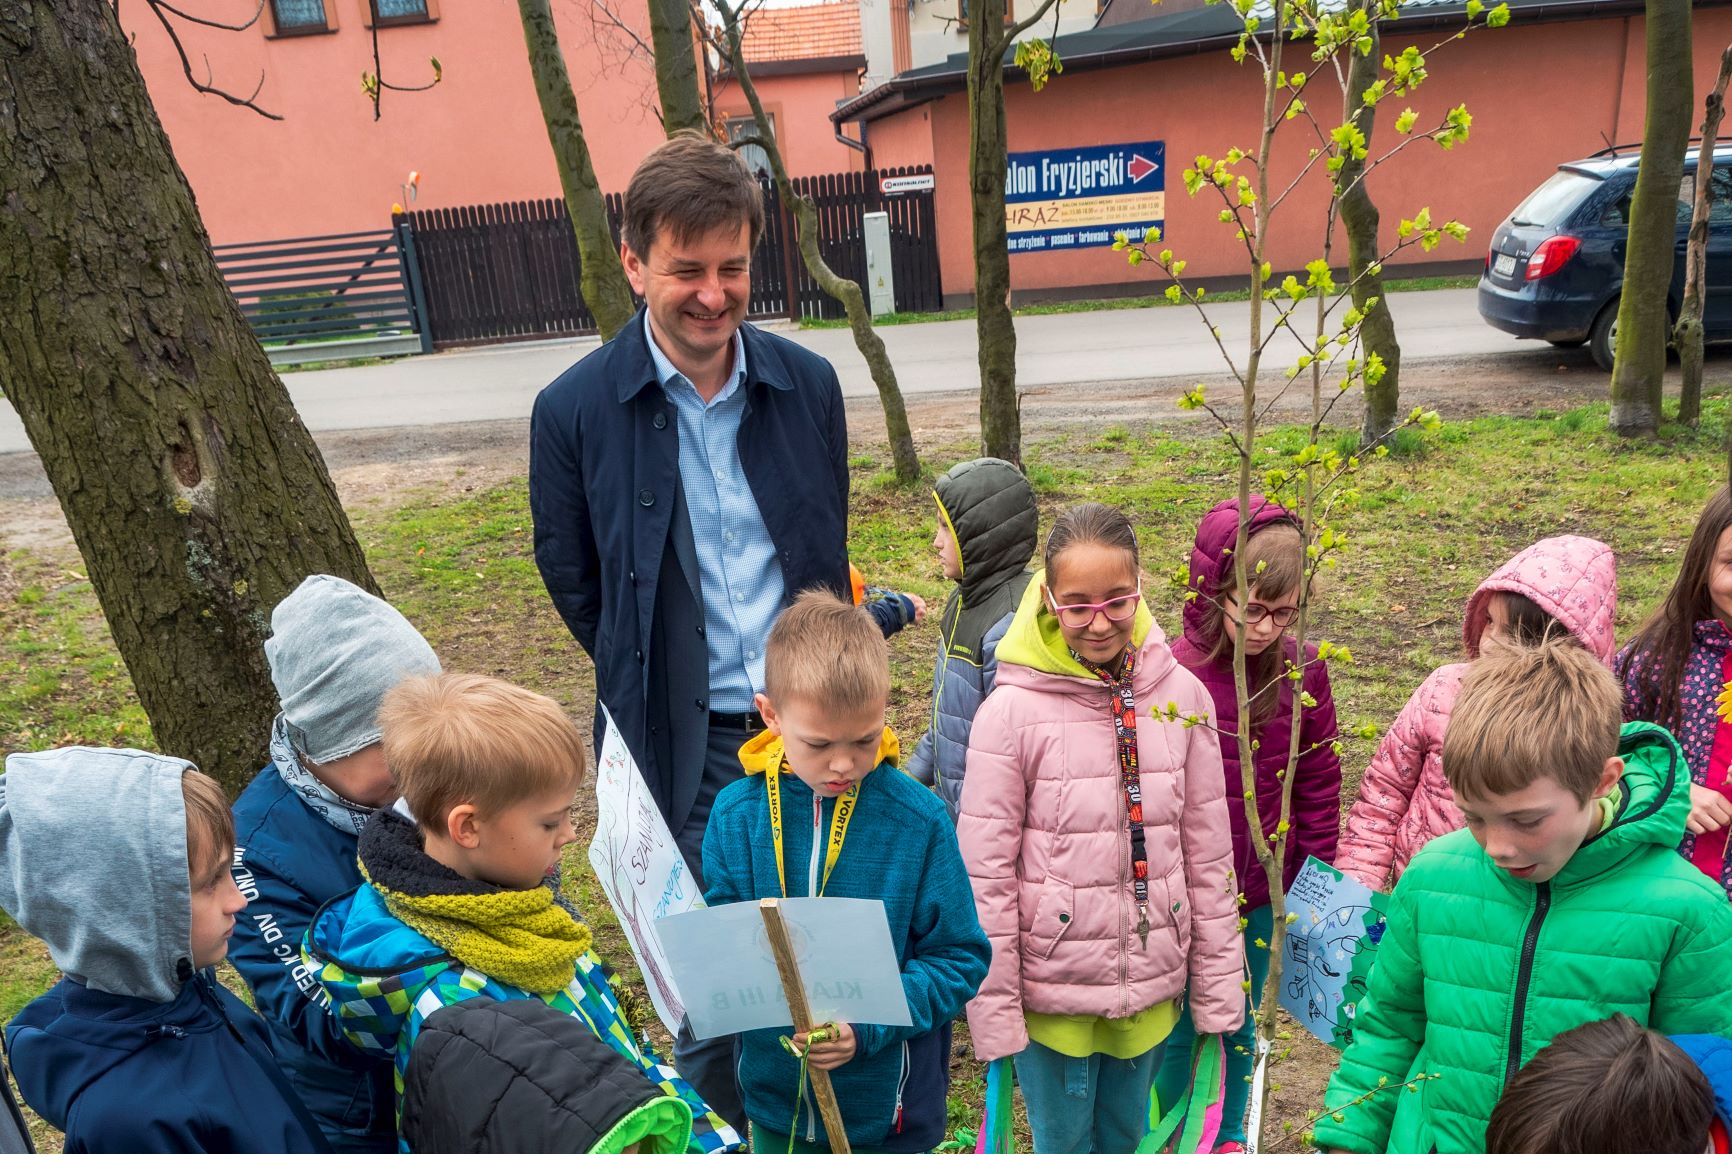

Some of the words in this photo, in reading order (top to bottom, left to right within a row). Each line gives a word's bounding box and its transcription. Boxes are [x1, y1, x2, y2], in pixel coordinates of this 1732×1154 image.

[1005, 161, 1036, 195] alon
[1042, 152, 1124, 196] Fryzjerski
[1078, 229, 1109, 243] farbowanie
[768, 775, 779, 824] VORTEX
[833, 799, 854, 847] VORTEX
[252, 912, 284, 945] DIV
